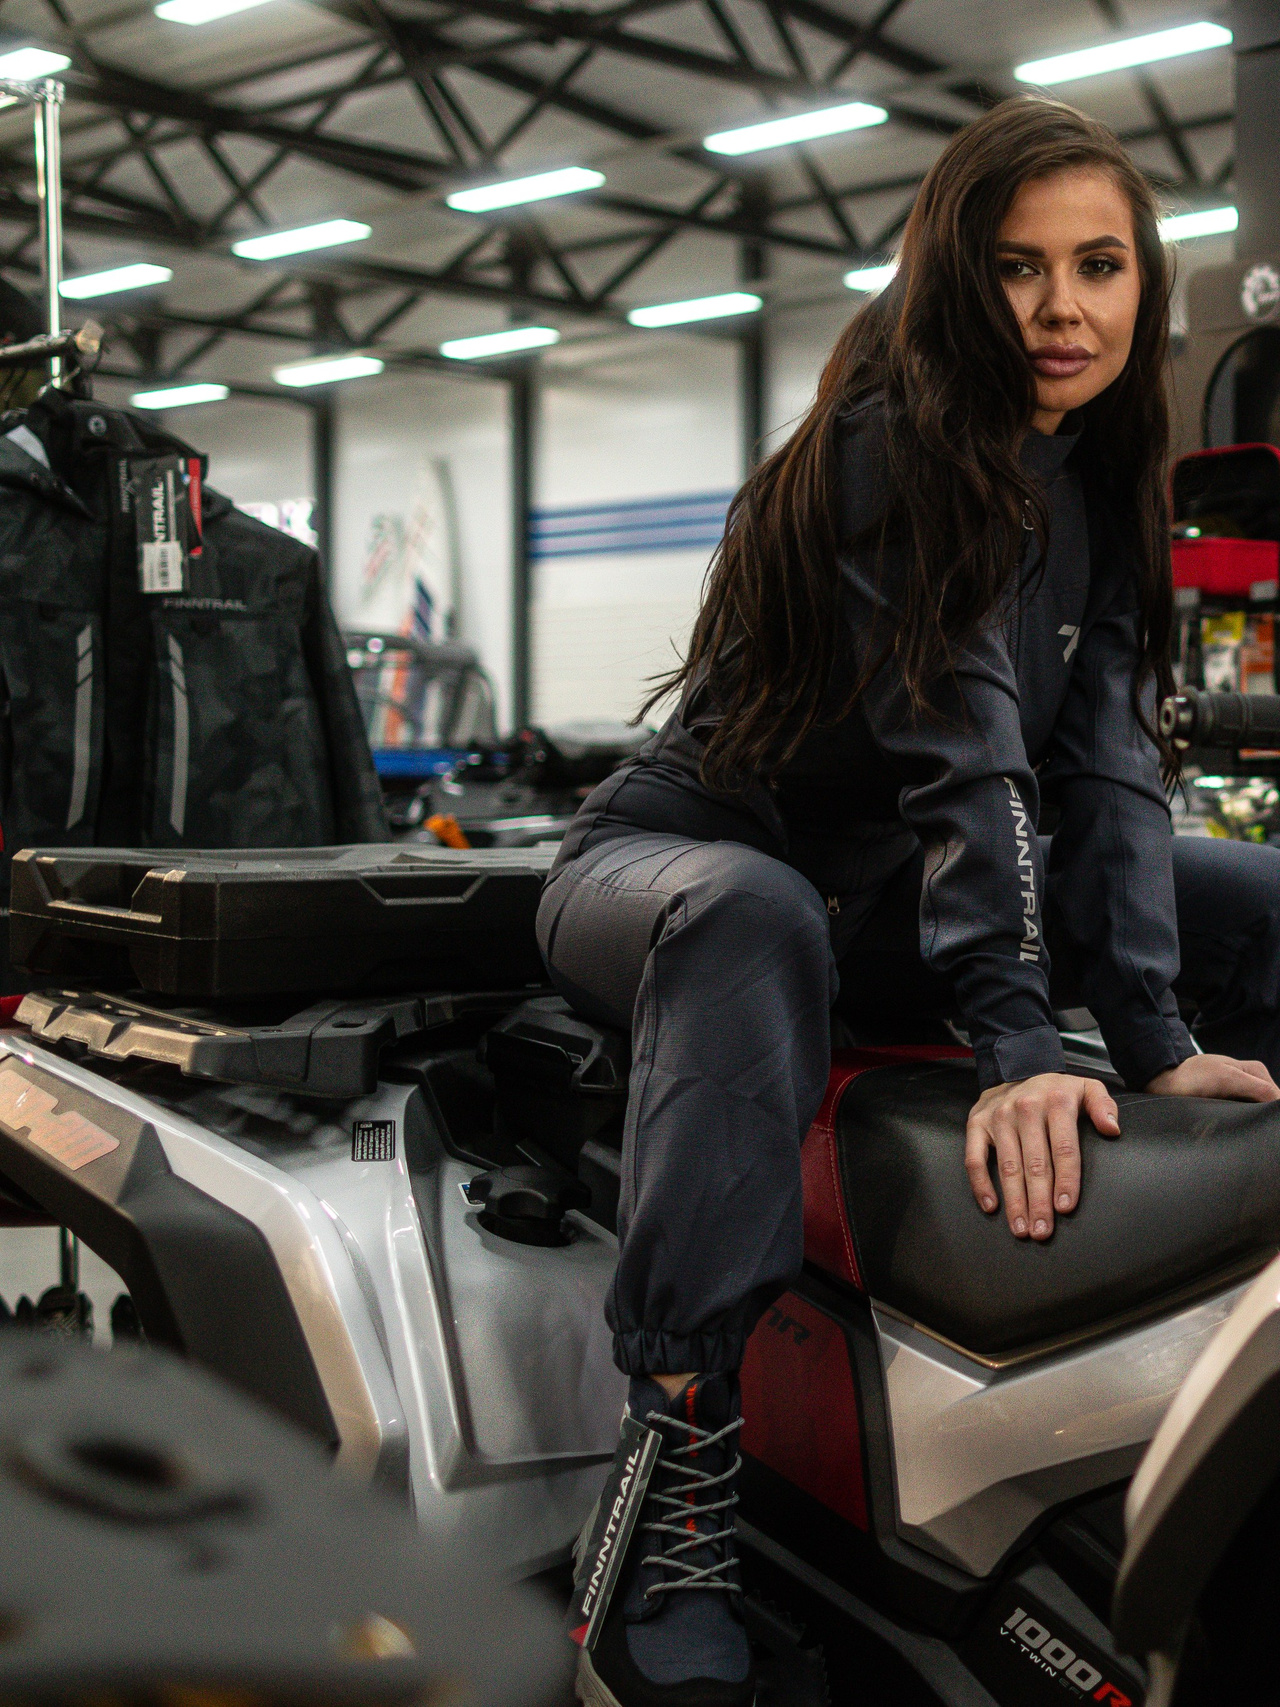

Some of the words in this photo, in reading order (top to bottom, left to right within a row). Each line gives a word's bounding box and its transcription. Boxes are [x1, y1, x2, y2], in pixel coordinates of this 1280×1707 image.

[1003, 776, 1041, 962] FINNTRAIL
[581, 1448, 640, 1617] FINNTRAIL
[1000, 1627, 1057, 1678] V-TWIN
[1004, 1607, 1132, 1707] 1000R
